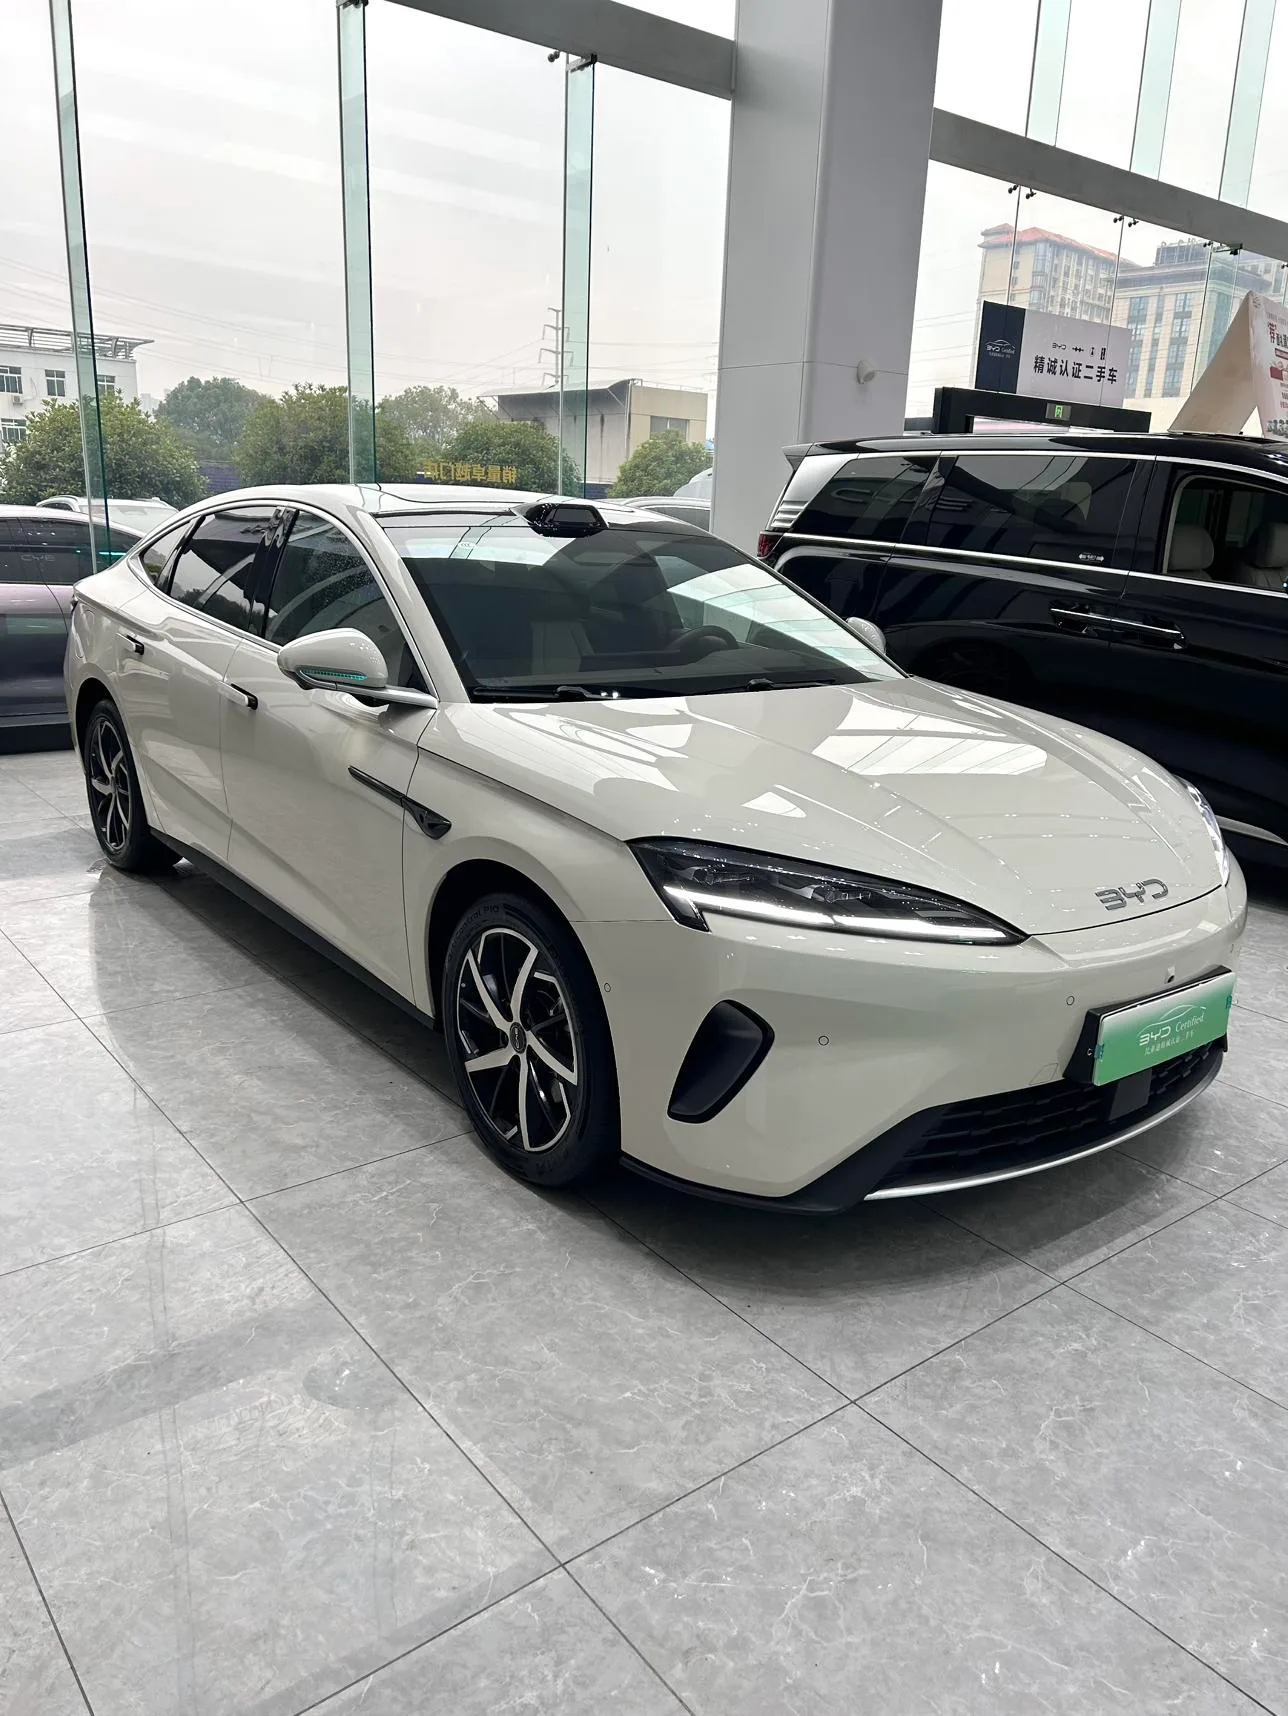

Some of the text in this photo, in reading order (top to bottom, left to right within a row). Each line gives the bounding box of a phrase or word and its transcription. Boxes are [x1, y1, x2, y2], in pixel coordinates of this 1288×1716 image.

[986, 344, 1001, 352] BYD
[1033, 354, 1118, 384] 精诚认证二手车
[1094, 878, 1169, 911] BYD
[1139, 1026, 1171, 1046] BYD
[1175, 1012, 1205, 1033] Certified
